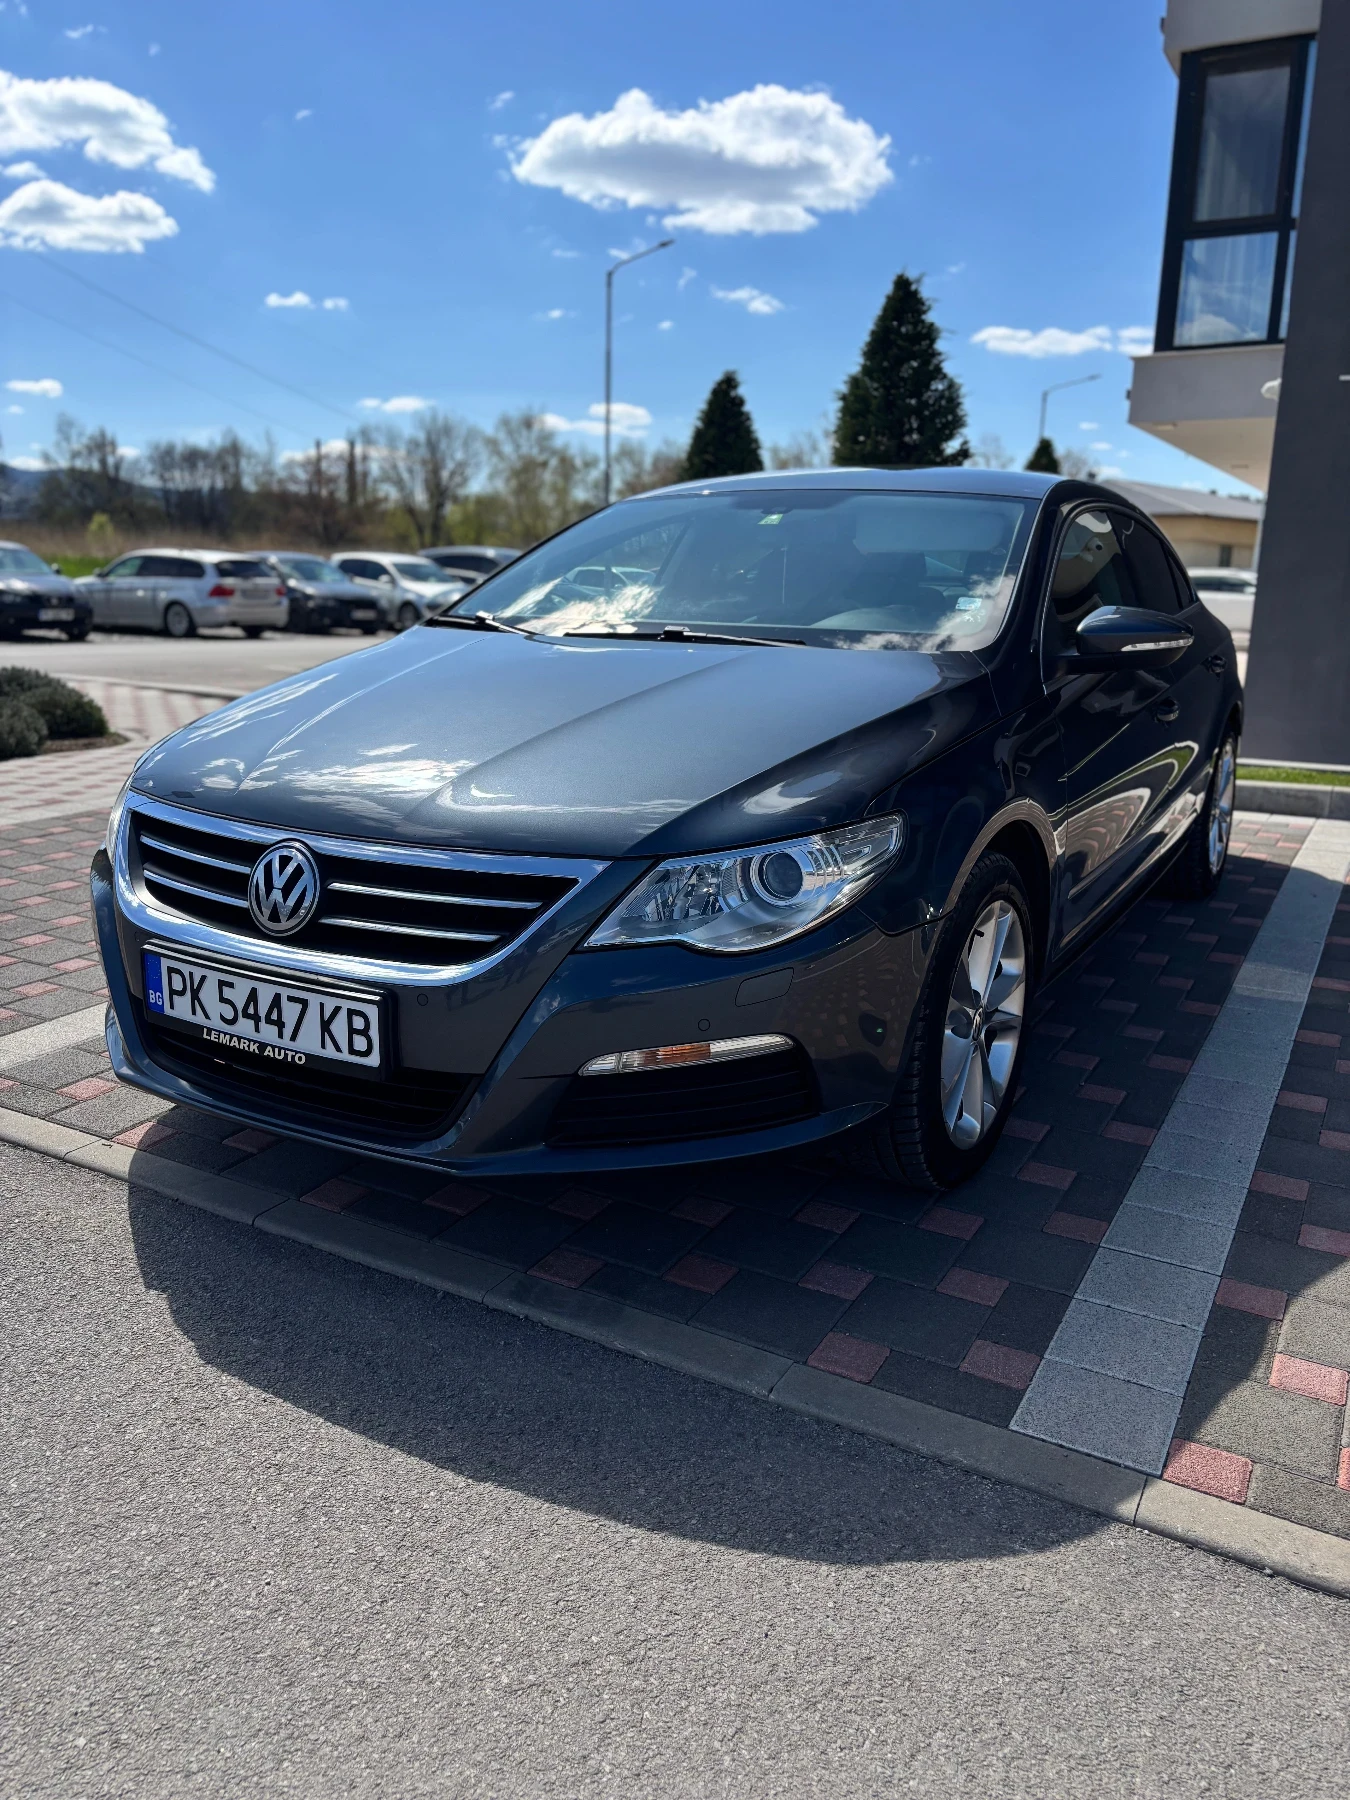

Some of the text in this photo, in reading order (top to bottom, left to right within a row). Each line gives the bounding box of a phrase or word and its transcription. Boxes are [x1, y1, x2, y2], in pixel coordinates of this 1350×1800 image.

[251, 846, 316, 932] VW
[148, 990, 163, 1006] BG
[166, 965, 375, 1058] PK 5447 KB
[202, 1027, 306, 1065] LEMARK AUTO
